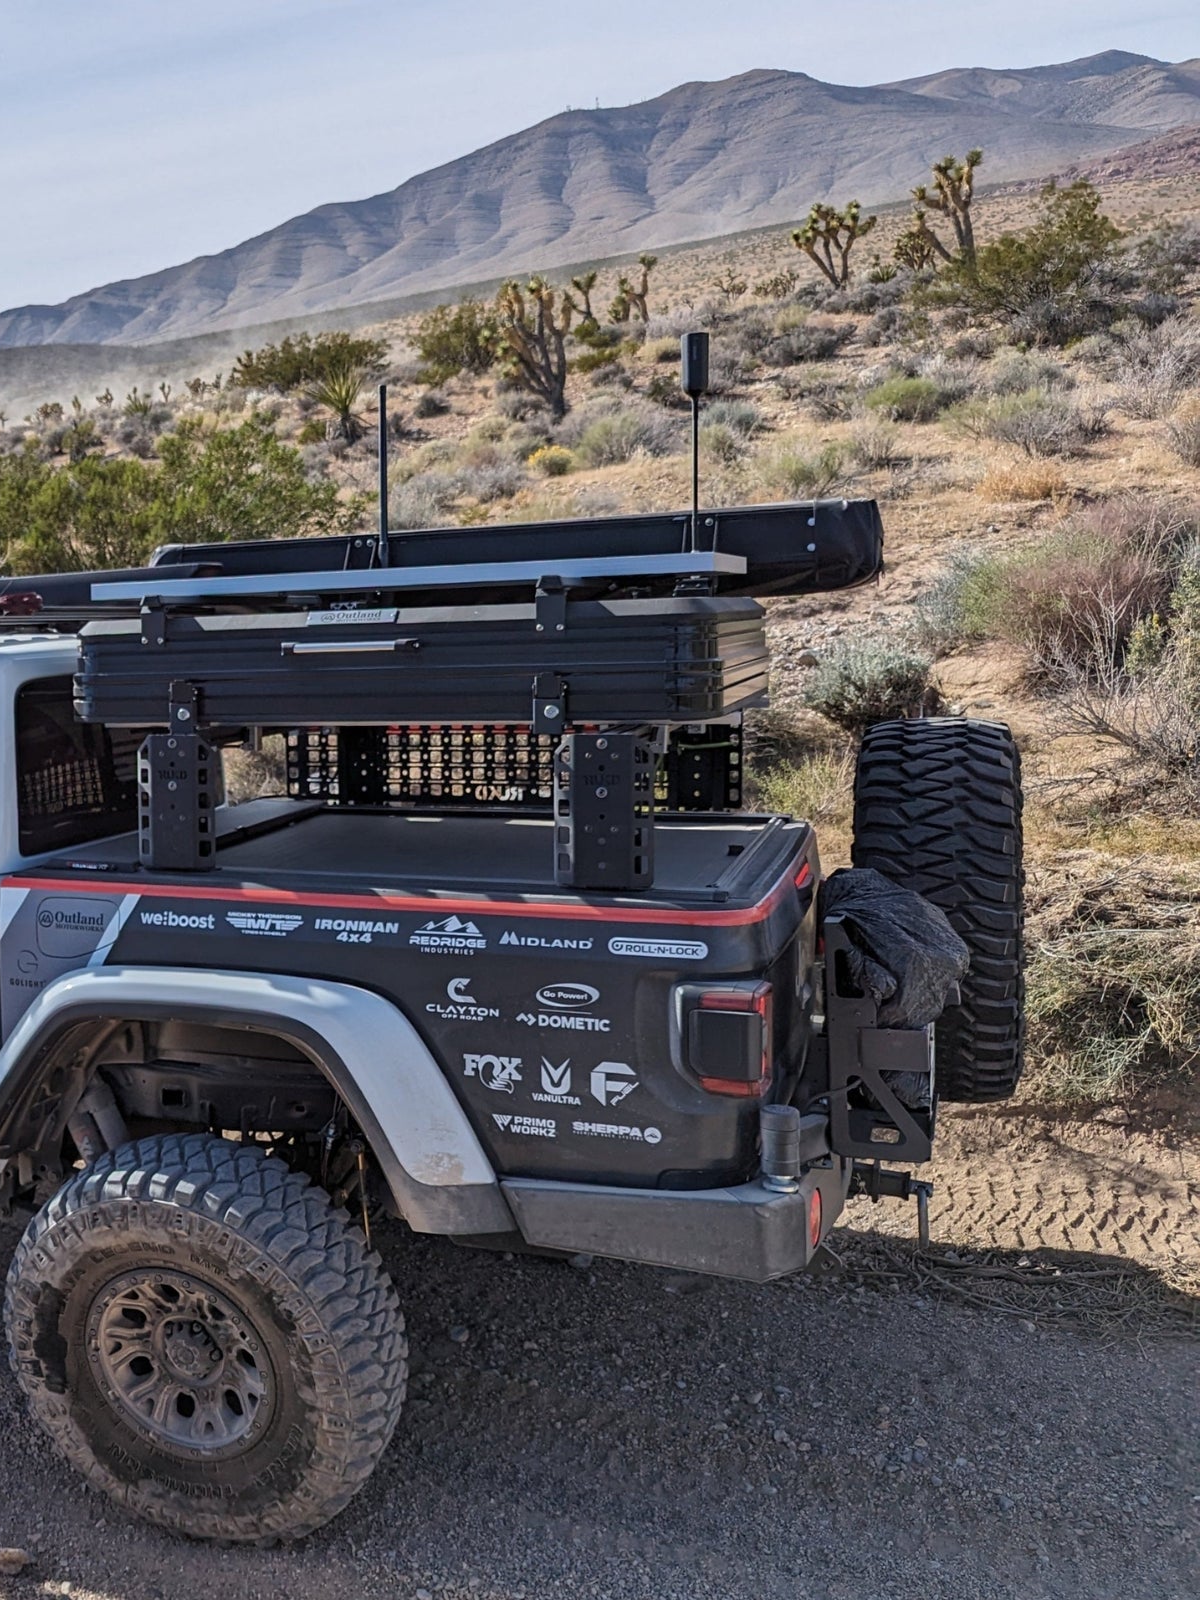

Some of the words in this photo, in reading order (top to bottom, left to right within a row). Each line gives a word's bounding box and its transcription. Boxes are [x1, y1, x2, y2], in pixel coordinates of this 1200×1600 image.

[336, 610, 382, 619] Outland
[54, 910, 104, 926] Outland
[315, 918, 399, 934] IRONMAN
[336, 932, 372, 943] 4x4
[409, 935, 487, 949] REDRIDGE
[499, 931, 593, 950] MIDLAND
[421, 947, 474, 955] INDUSTRIES
[10, 977, 45, 988] GOLIGHT
[543, 990, 556, 998] Go
[557, 991, 588, 1000] Power!
[425, 1003, 500, 1018] CLAYTON
[538, 1014, 611, 1032] DOMETIC
[463, 1054, 522, 1094] FOX
[532, 1092, 581, 1105] VANULTRA
[514, 1115, 556, 1128] PRIMO
[509, 1124, 557, 1137] WORKZ
[571, 1121, 642, 1137] SHERPA
